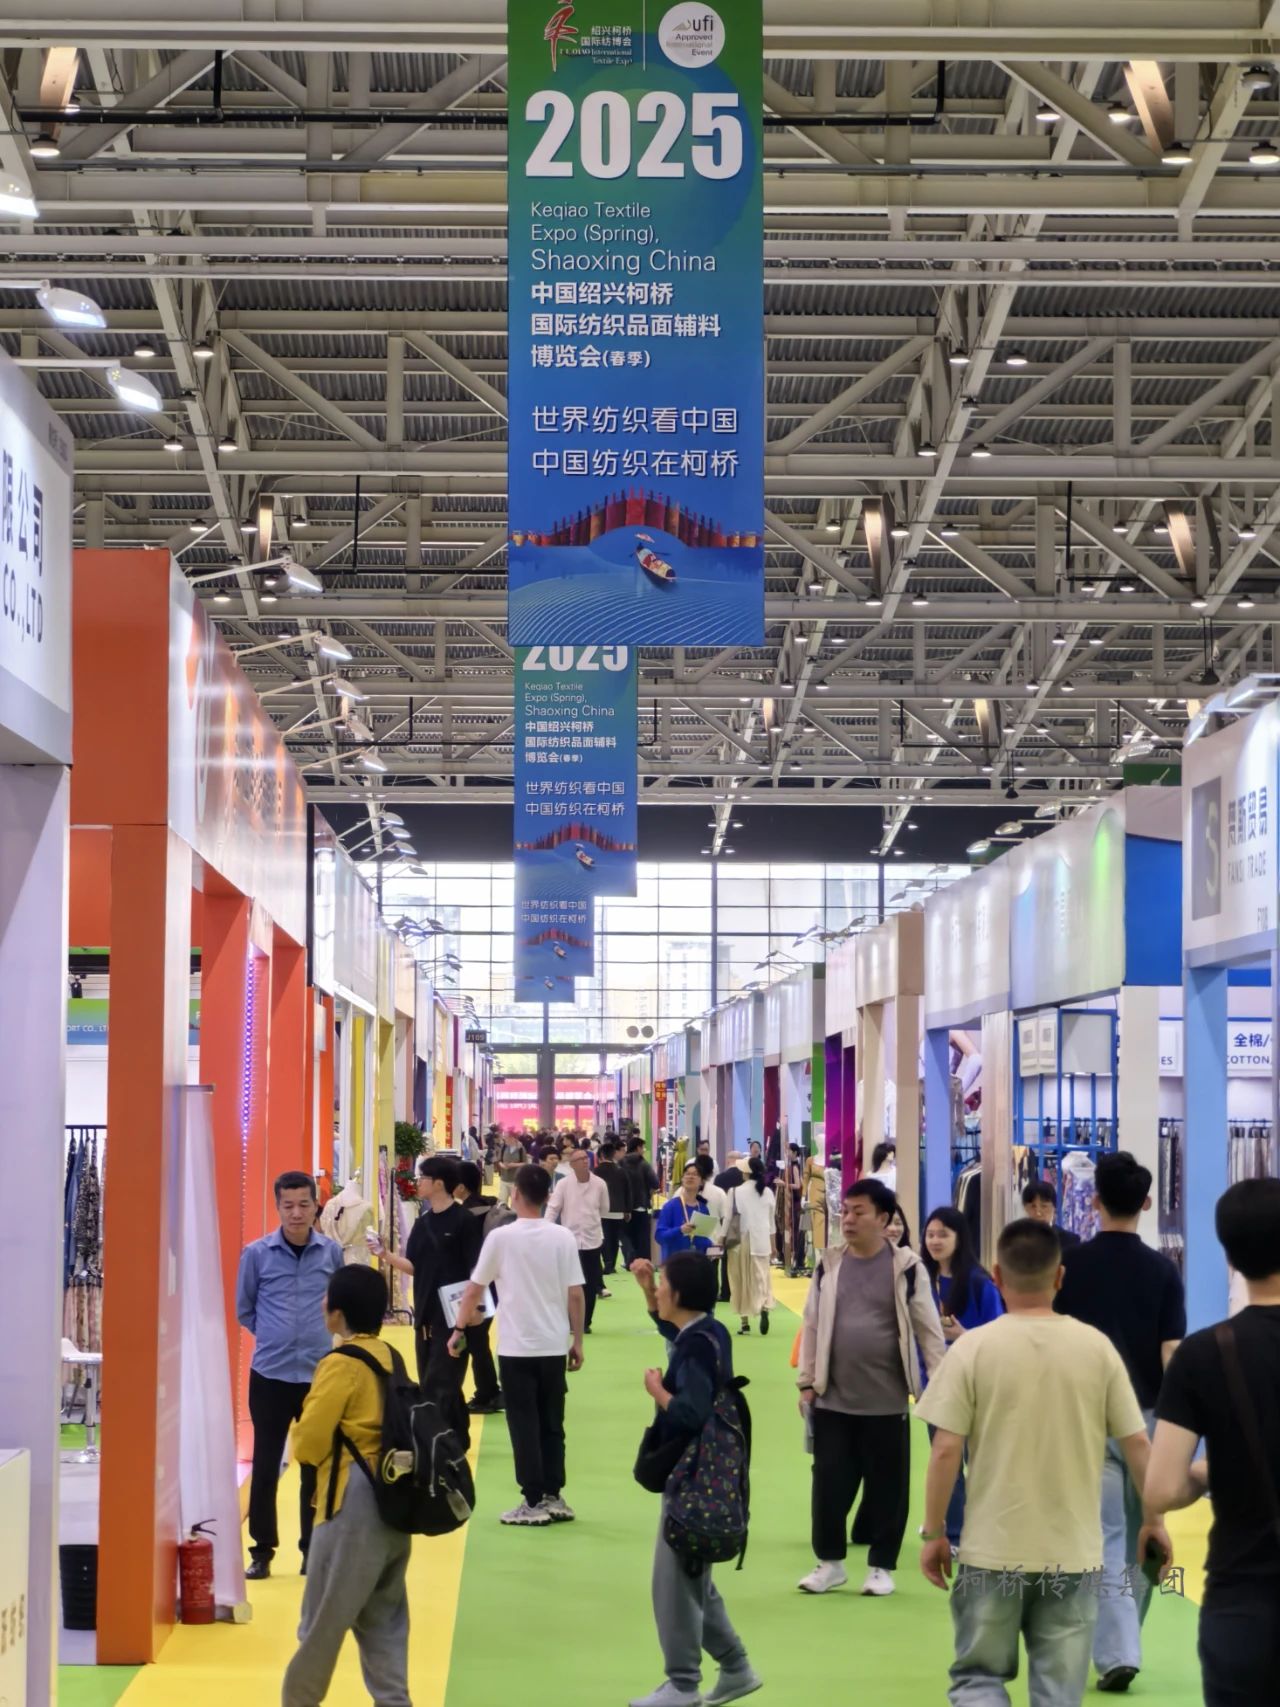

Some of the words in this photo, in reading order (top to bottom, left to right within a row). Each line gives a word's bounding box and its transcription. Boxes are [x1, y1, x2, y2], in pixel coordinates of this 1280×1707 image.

[591, 26, 632, 36] 绍兴柯桥
[692, 15, 714, 32] ufi
[580, 37, 632, 47] 国际纺博会
[675, 34, 713, 42] Approved
[691, 49, 713, 57] Event
[525, 90, 744, 180] 2025
[530, 202, 589, 221] Keqiao
[593, 202, 651, 218] Textile
[531, 224, 577, 246] Expo
[583, 224, 660, 245] (Spring),
[531, 249, 641, 275] Shaoxing
[650, 249, 717, 272] China
[530, 281, 674, 306] 中国绍兴柯桥
[530, 313, 722, 337] 国际纺织品面辅料
[530, 345, 651, 368] 博览会(春季)
[532, 406, 738, 434] 世界纺织看中国
[532, 449, 739, 477] 中国纺织在柯桥
[522, 646, 628, 671] 2025
[524, 682, 553, 692] Keqiao
[556, 682, 583, 690] Textile
[524, 693, 548, 703] Expo
[550, 693, 588, 703] (Spring),
[525, 705, 578, 718] Shaoxing
[582, 705, 615, 716] China
[525, 721, 594, 733] 中国绍兴柯桥
[525, 737, 616, 748] 国际纺织品面辅料
[526, 781, 625, 795] 世界纺织看中国
[525, 802, 625, 816] 中国纺织在柯桥
